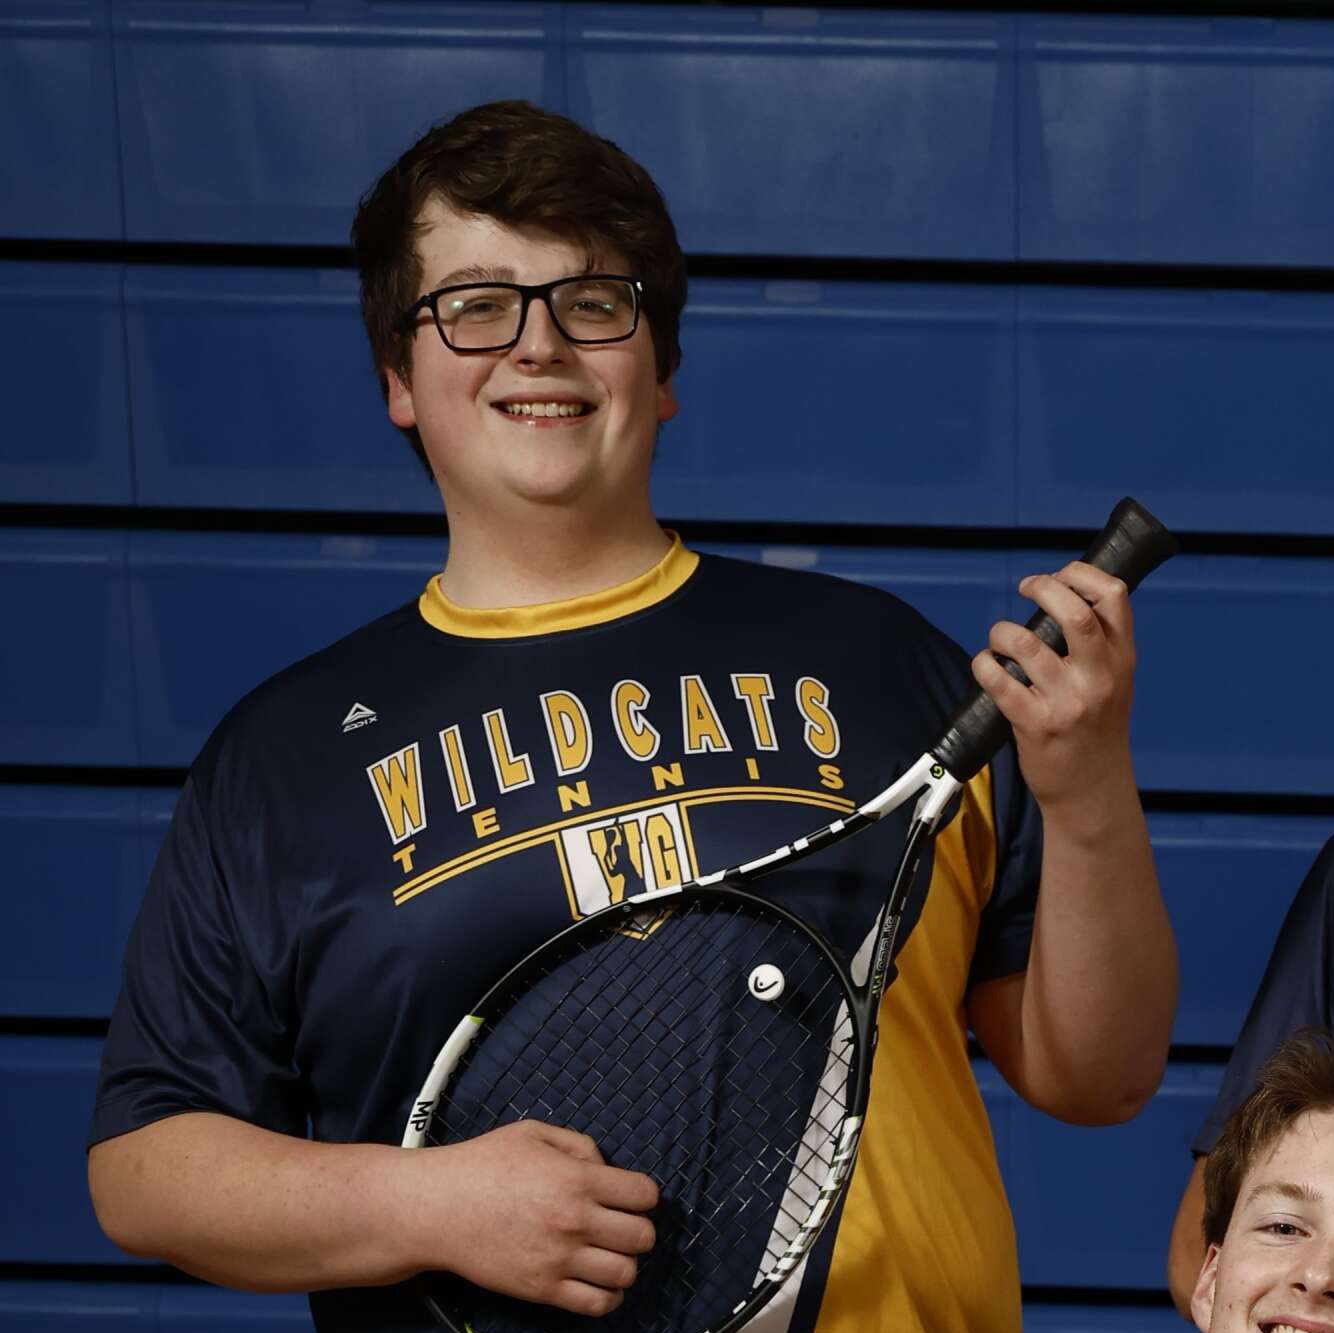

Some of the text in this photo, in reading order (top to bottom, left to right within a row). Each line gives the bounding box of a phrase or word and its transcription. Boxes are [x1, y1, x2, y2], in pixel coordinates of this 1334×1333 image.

[366, 673, 841, 844] WILDCATS
[392, 757, 845, 873] TENNIS
[409, 1100, 434, 1133] MP
